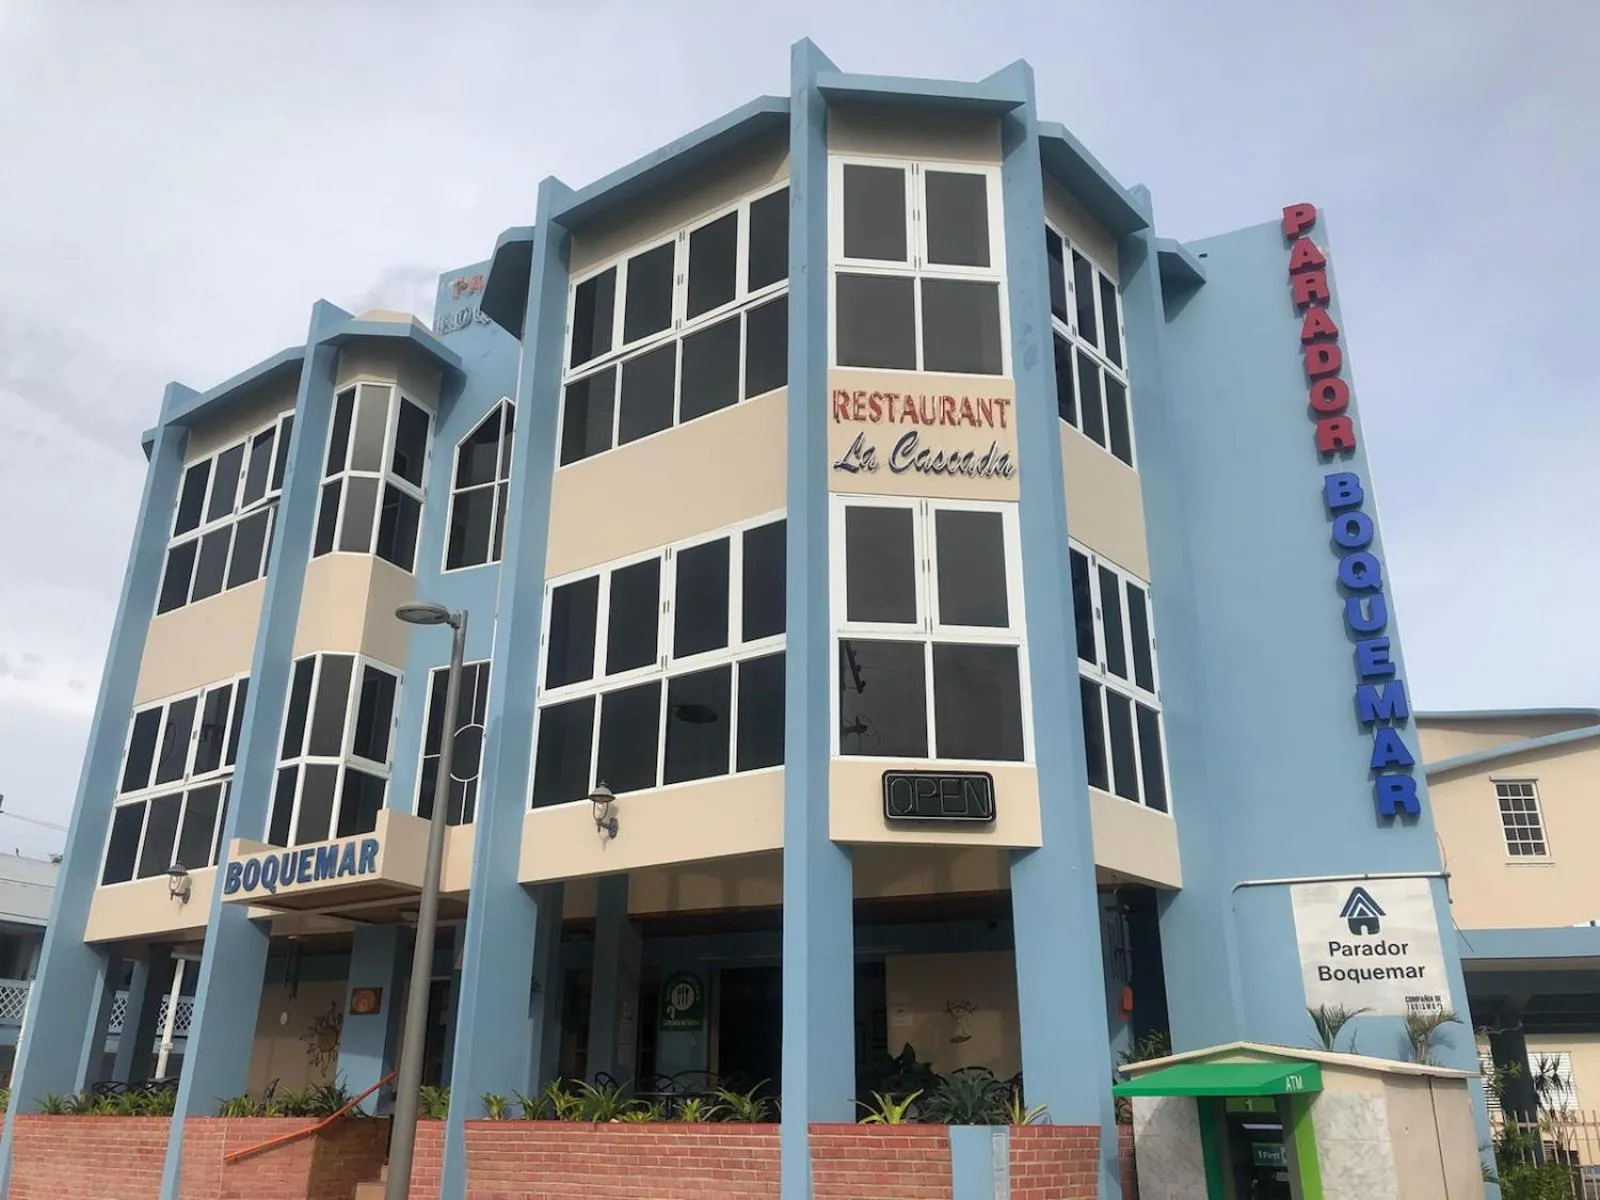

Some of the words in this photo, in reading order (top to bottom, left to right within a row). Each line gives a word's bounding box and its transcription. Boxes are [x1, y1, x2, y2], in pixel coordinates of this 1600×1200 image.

[832, 389, 1011, 428] RESTAURANT
[833, 431, 878, 473] La
[888, 430, 1016, 479] Cascada
[1281, 202, 1356, 455] PARADOR
[1323, 472, 1421, 816] BOQUEMAR
[890, 778, 988, 815] OPEN
[224, 838, 380, 895] BOQUEMAR
[1328, 940, 1409, 957] Parador
[1318, 965, 1425, 984] Boquemar
[1285, 1075, 1304, 1092] ATM
